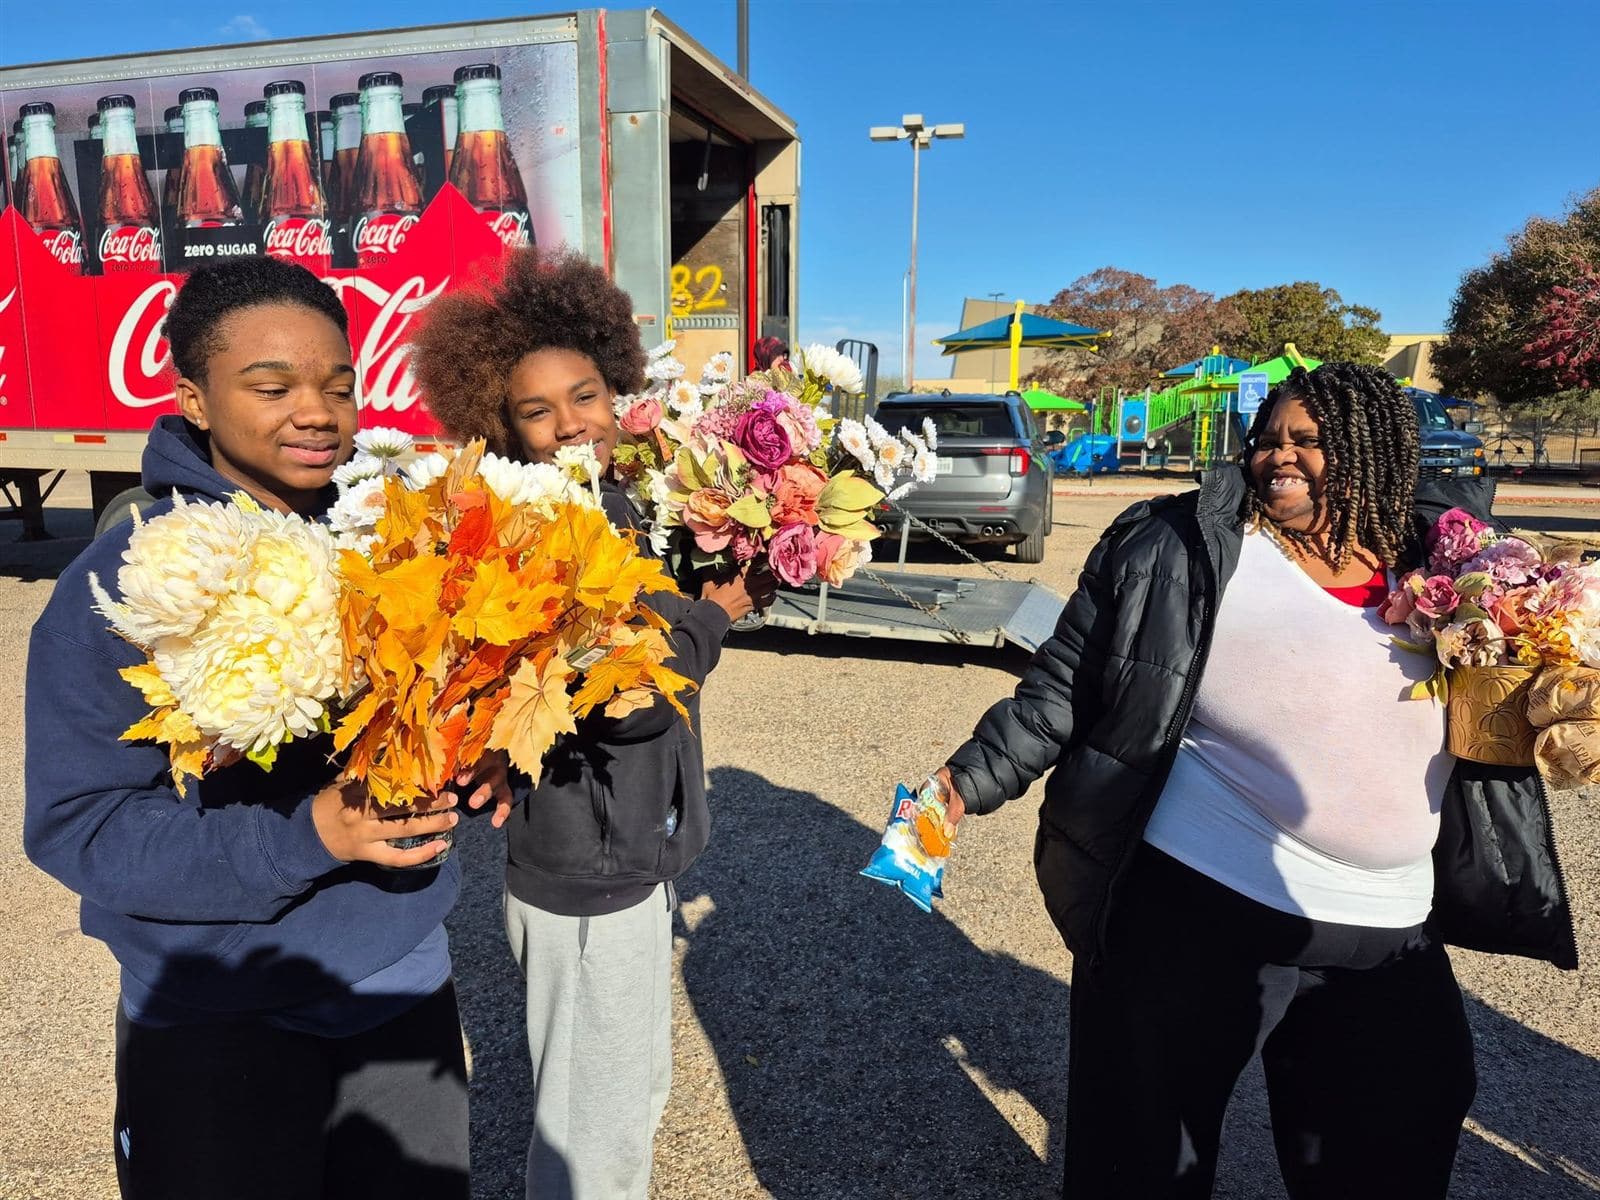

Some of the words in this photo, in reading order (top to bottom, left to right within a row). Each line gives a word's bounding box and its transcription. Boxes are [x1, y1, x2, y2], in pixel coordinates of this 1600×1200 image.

[98, 226, 163, 262] Coca-Cola
[184, 243, 215, 258] zero
[216, 242, 258, 256] SUGAR
[263, 218, 335, 257] Coca-Cola
[352, 214, 420, 254] Coca-C
